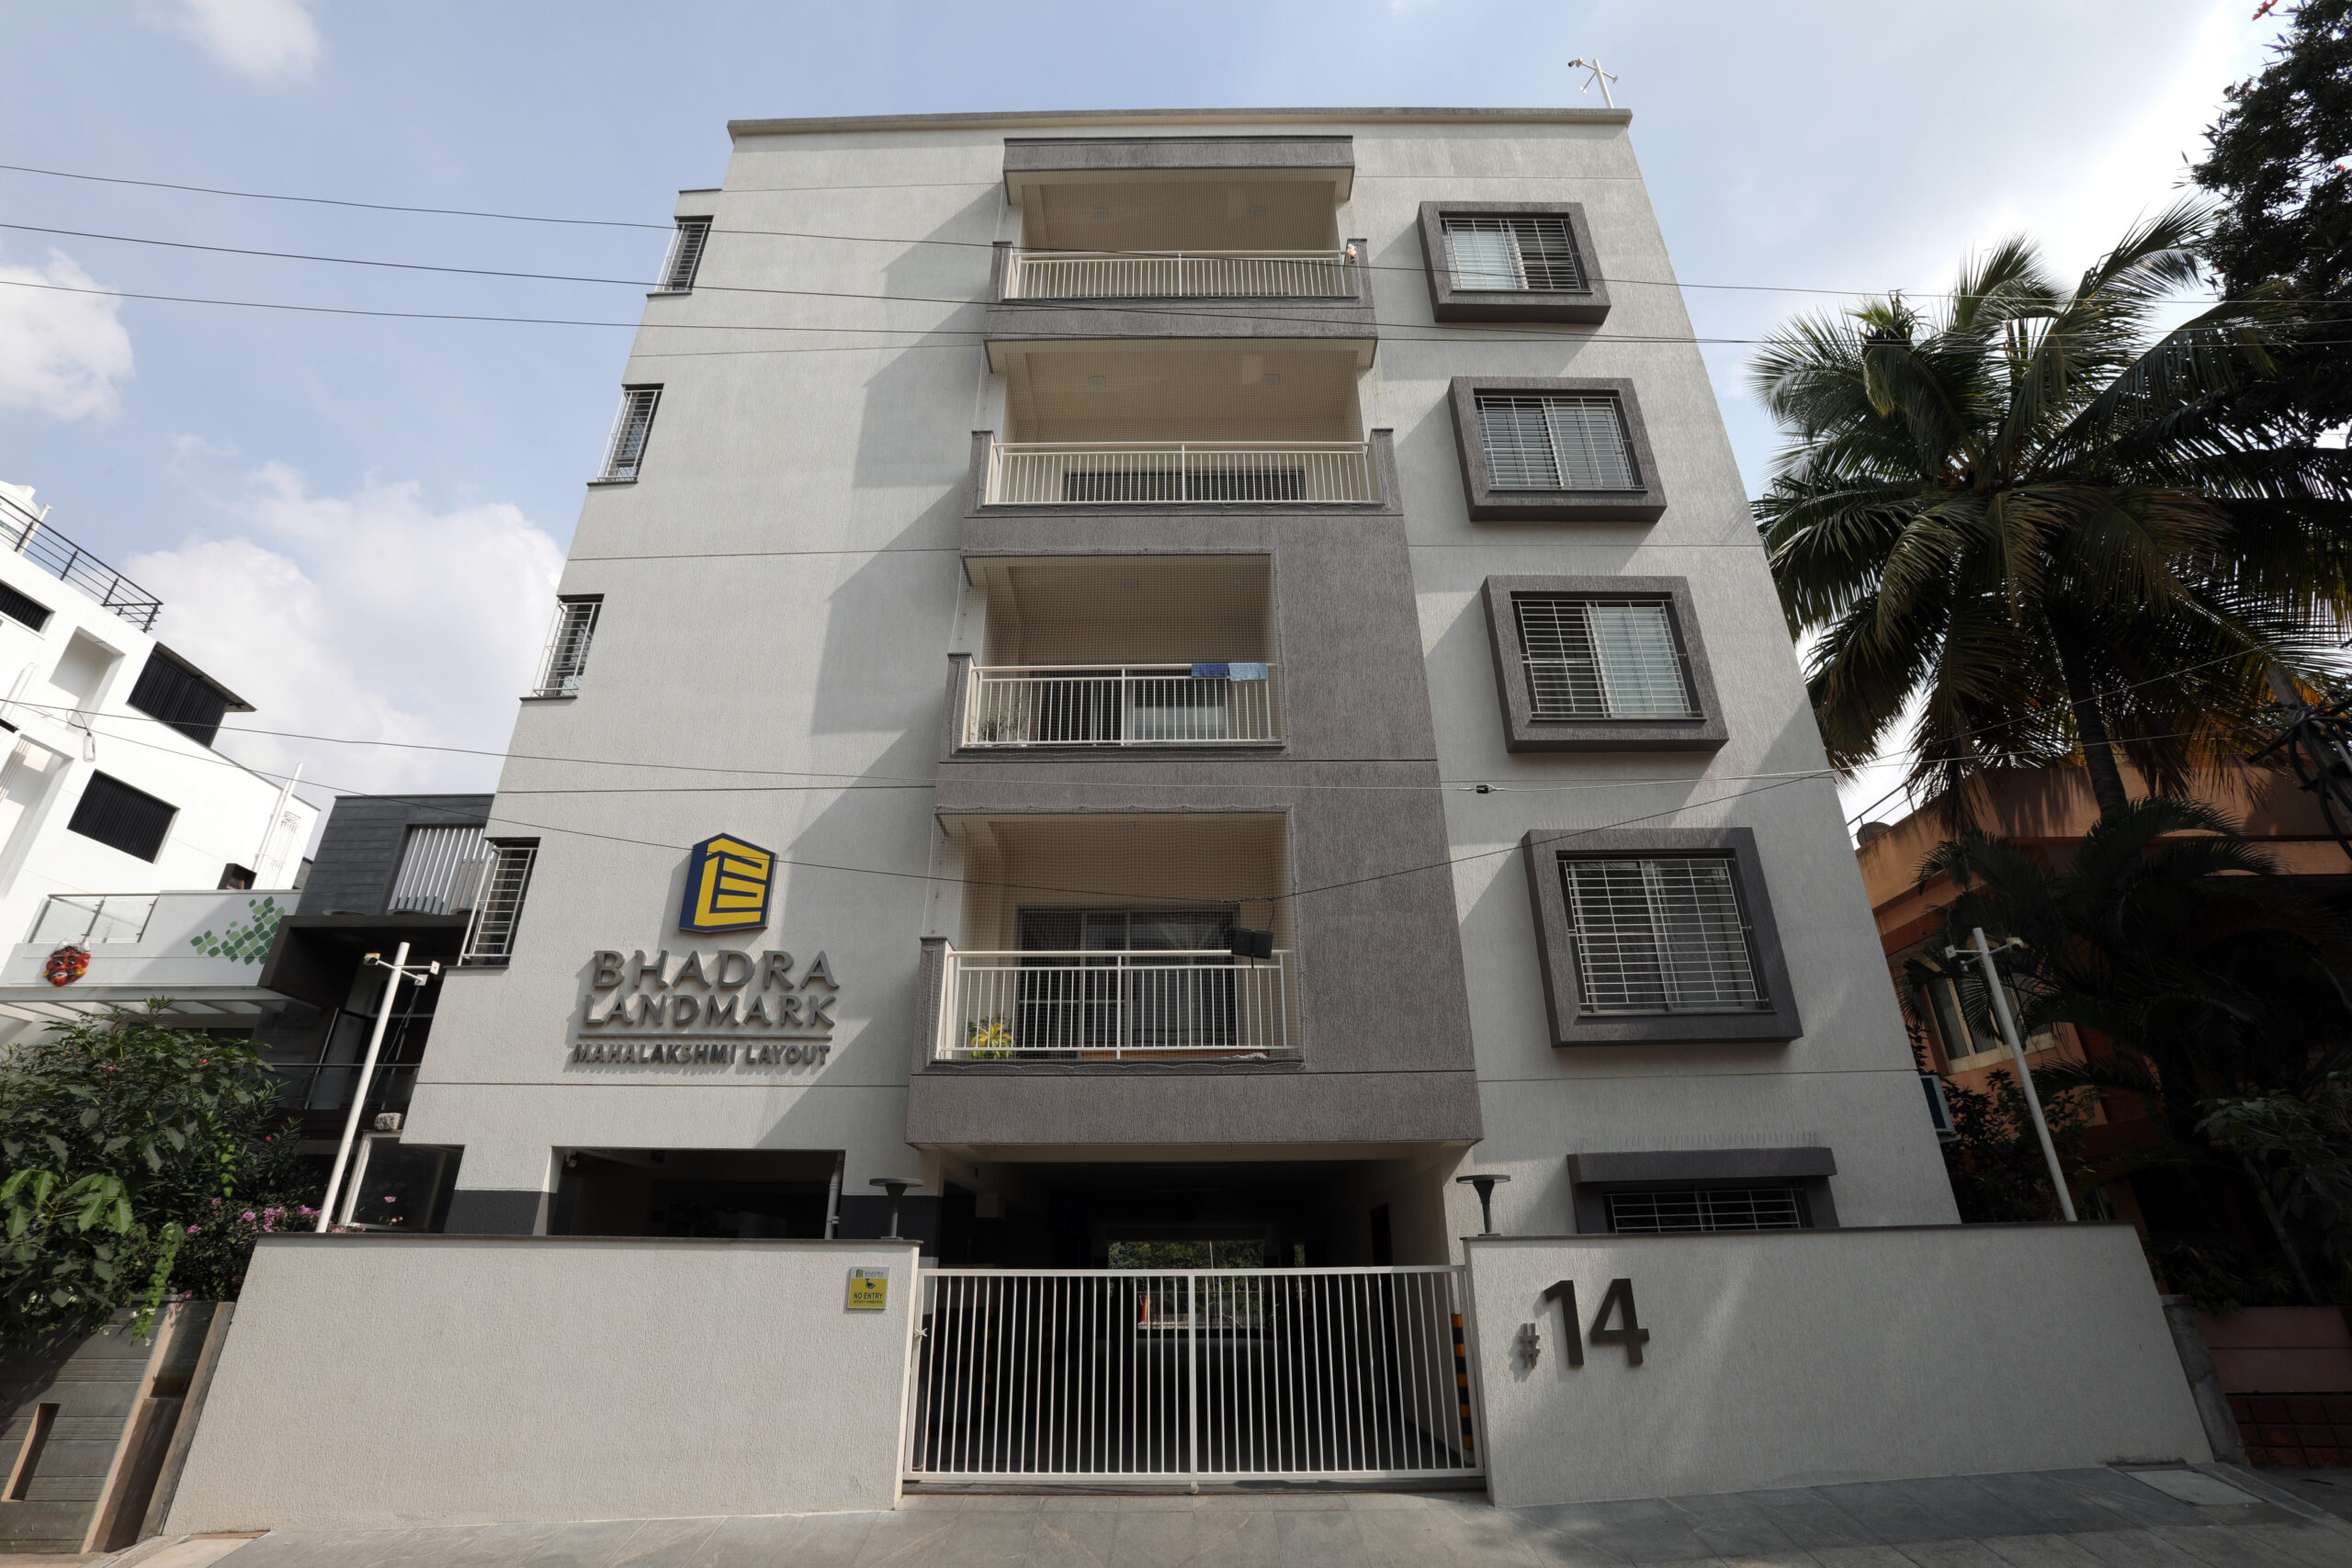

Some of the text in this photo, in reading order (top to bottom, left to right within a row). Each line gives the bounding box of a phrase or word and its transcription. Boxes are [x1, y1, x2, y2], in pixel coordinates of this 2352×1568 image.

[593, 950, 840, 989] BHADRA
[584, 994, 837, 1027] LANDMARK
[572, 1043, 831, 1066] MAHALAKSHMI LAYOUT
[854, 1292, 884, 1300] NO ENTRY
